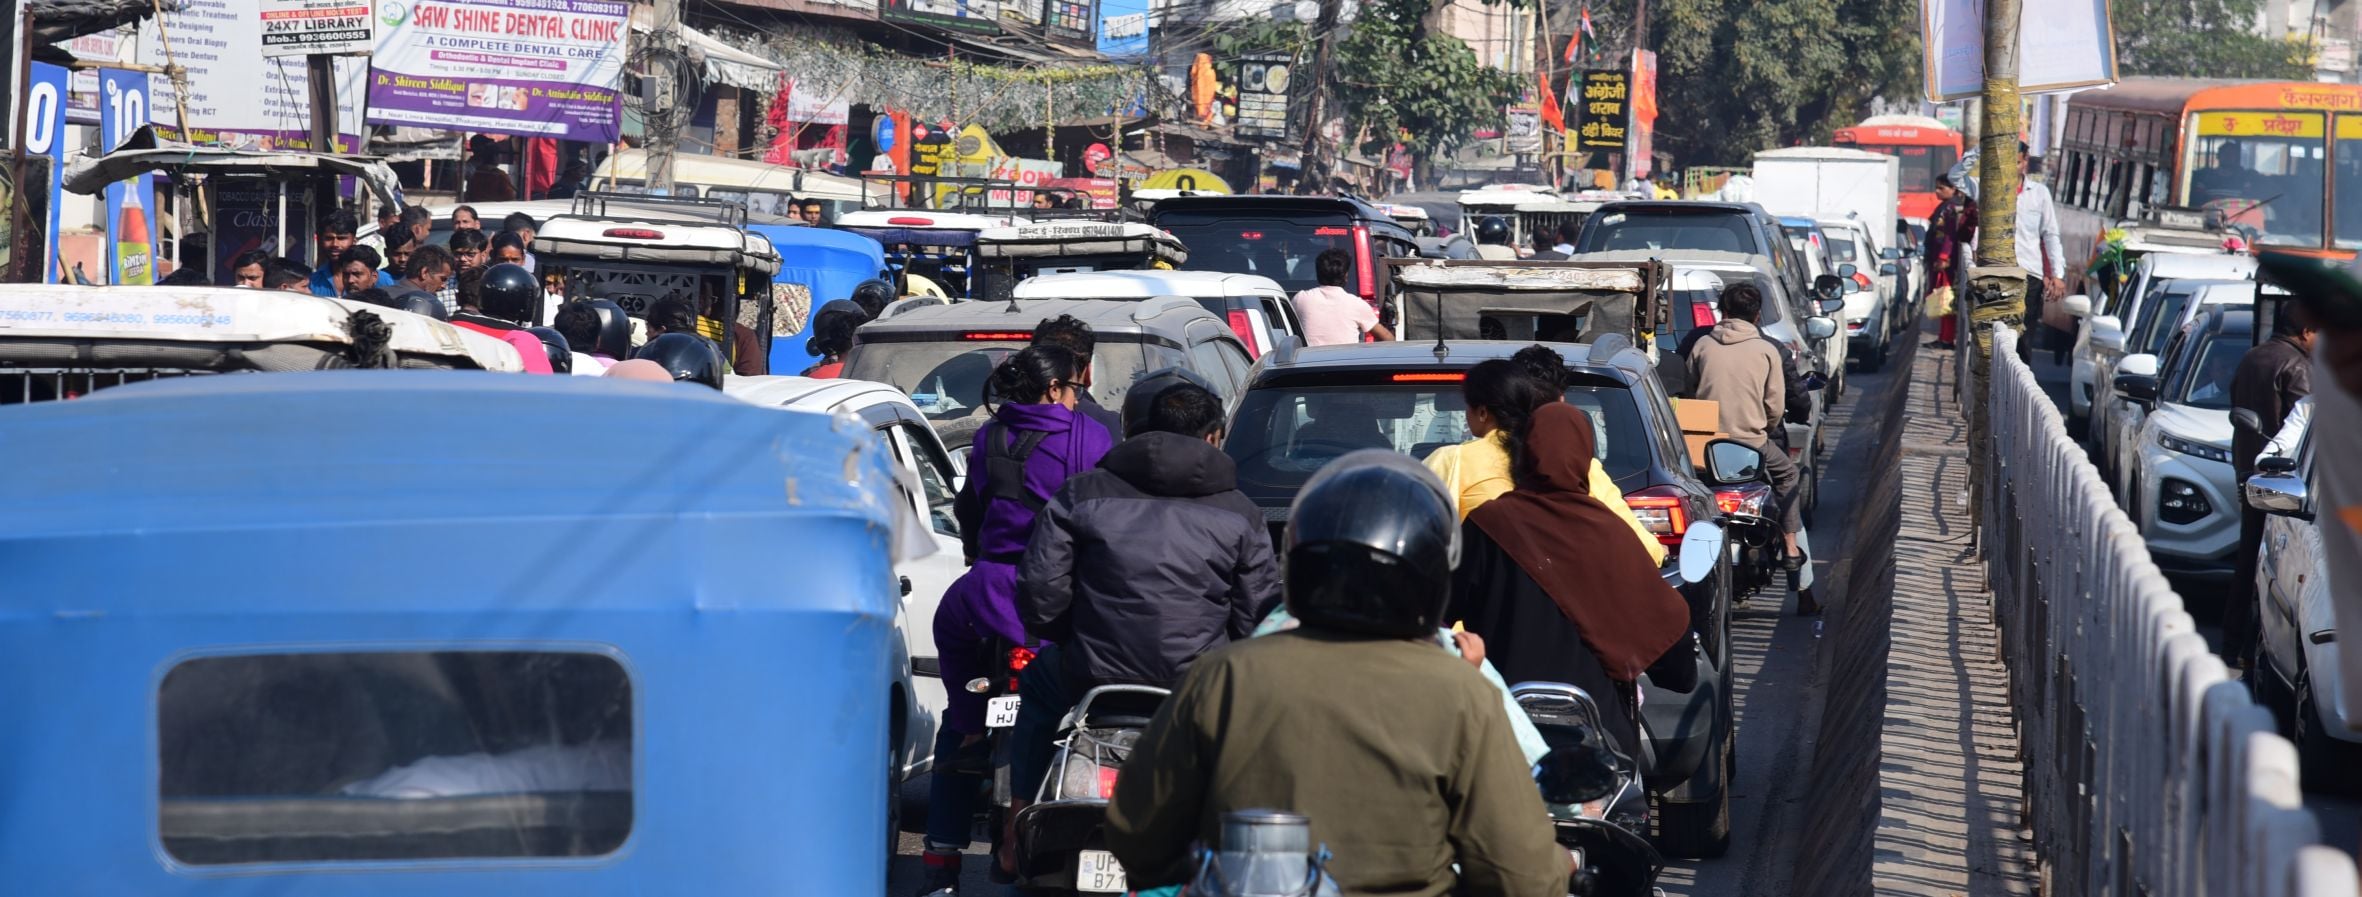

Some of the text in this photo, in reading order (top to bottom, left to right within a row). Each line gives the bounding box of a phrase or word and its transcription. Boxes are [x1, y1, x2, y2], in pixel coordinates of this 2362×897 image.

[202, 10, 238, 20] Treatment
[179, 21, 214, 33] Designing
[266, 17, 364, 32] 24X7 LIBRARY
[413, 4, 619, 42] SAW SHINE DENTAL CLINIC
[426, 36, 605, 59] A COMPLETE DENTAL CARE
[190, 51, 218, 61] Denture
[996, 713, 1013, 724] HJ
